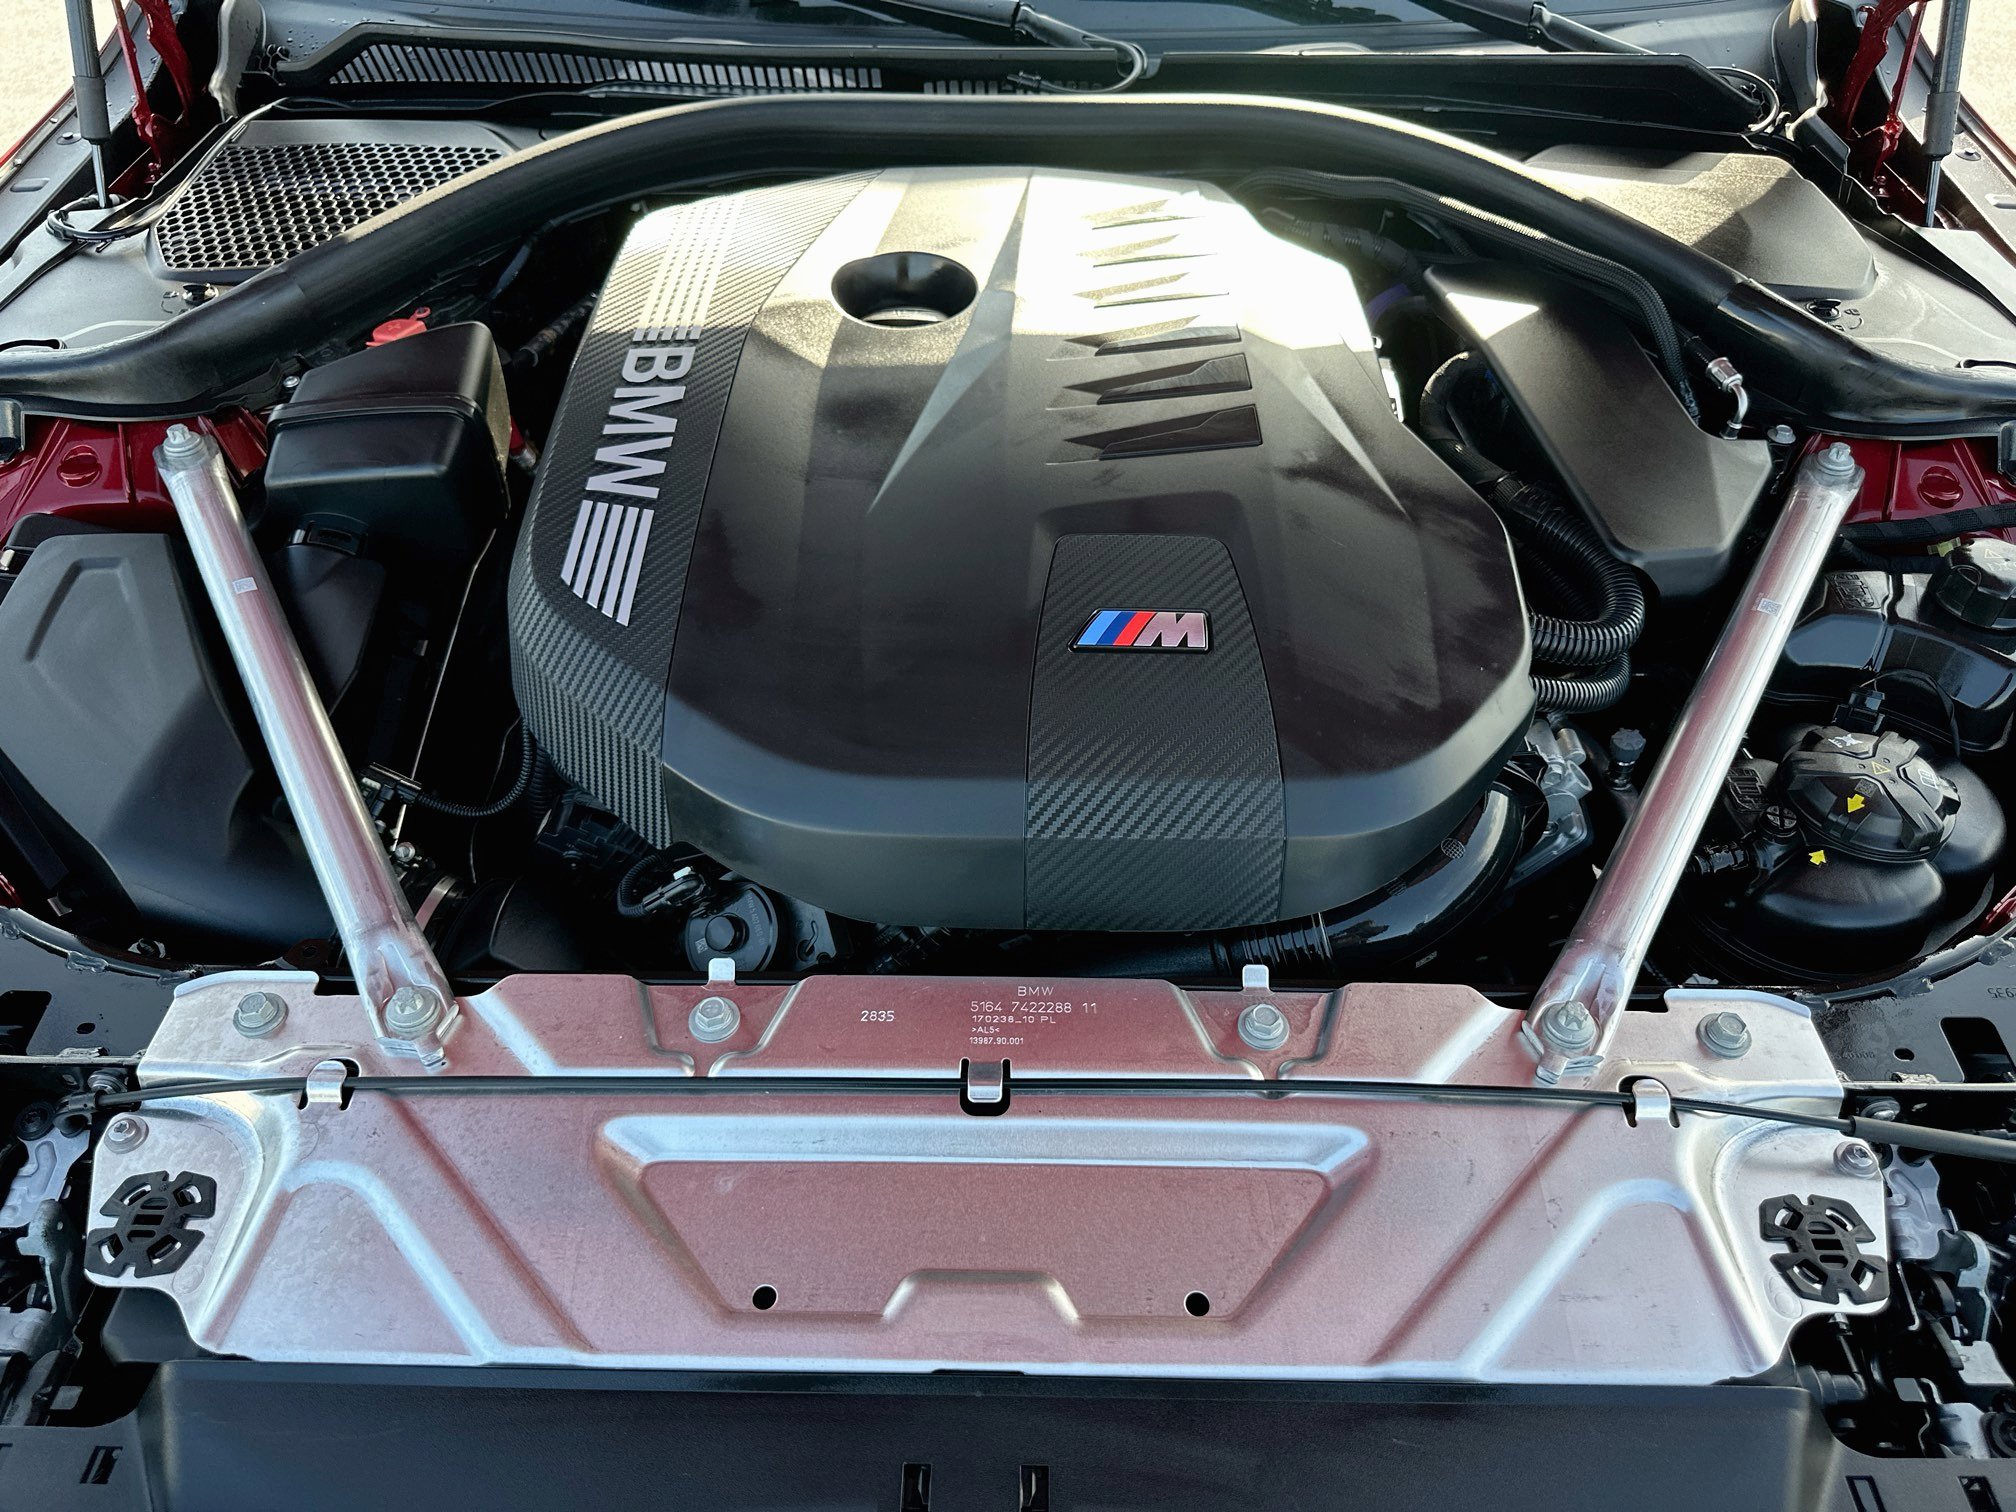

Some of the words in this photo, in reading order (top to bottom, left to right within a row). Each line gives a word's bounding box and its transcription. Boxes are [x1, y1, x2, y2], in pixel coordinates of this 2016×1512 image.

[585, 346, 696, 499] BMW
[1133, 611, 1206, 647] M
[1017, 985, 1055, 997] BMW
[970, 1001, 1003, 1012] 5164
[1011, 1001, 1072, 1013] 7422288
[1082, 1002, 1097, 1014] 11
[860, 1010, 895, 1022] 2835
[1040, 1015, 1057, 1024] PL
